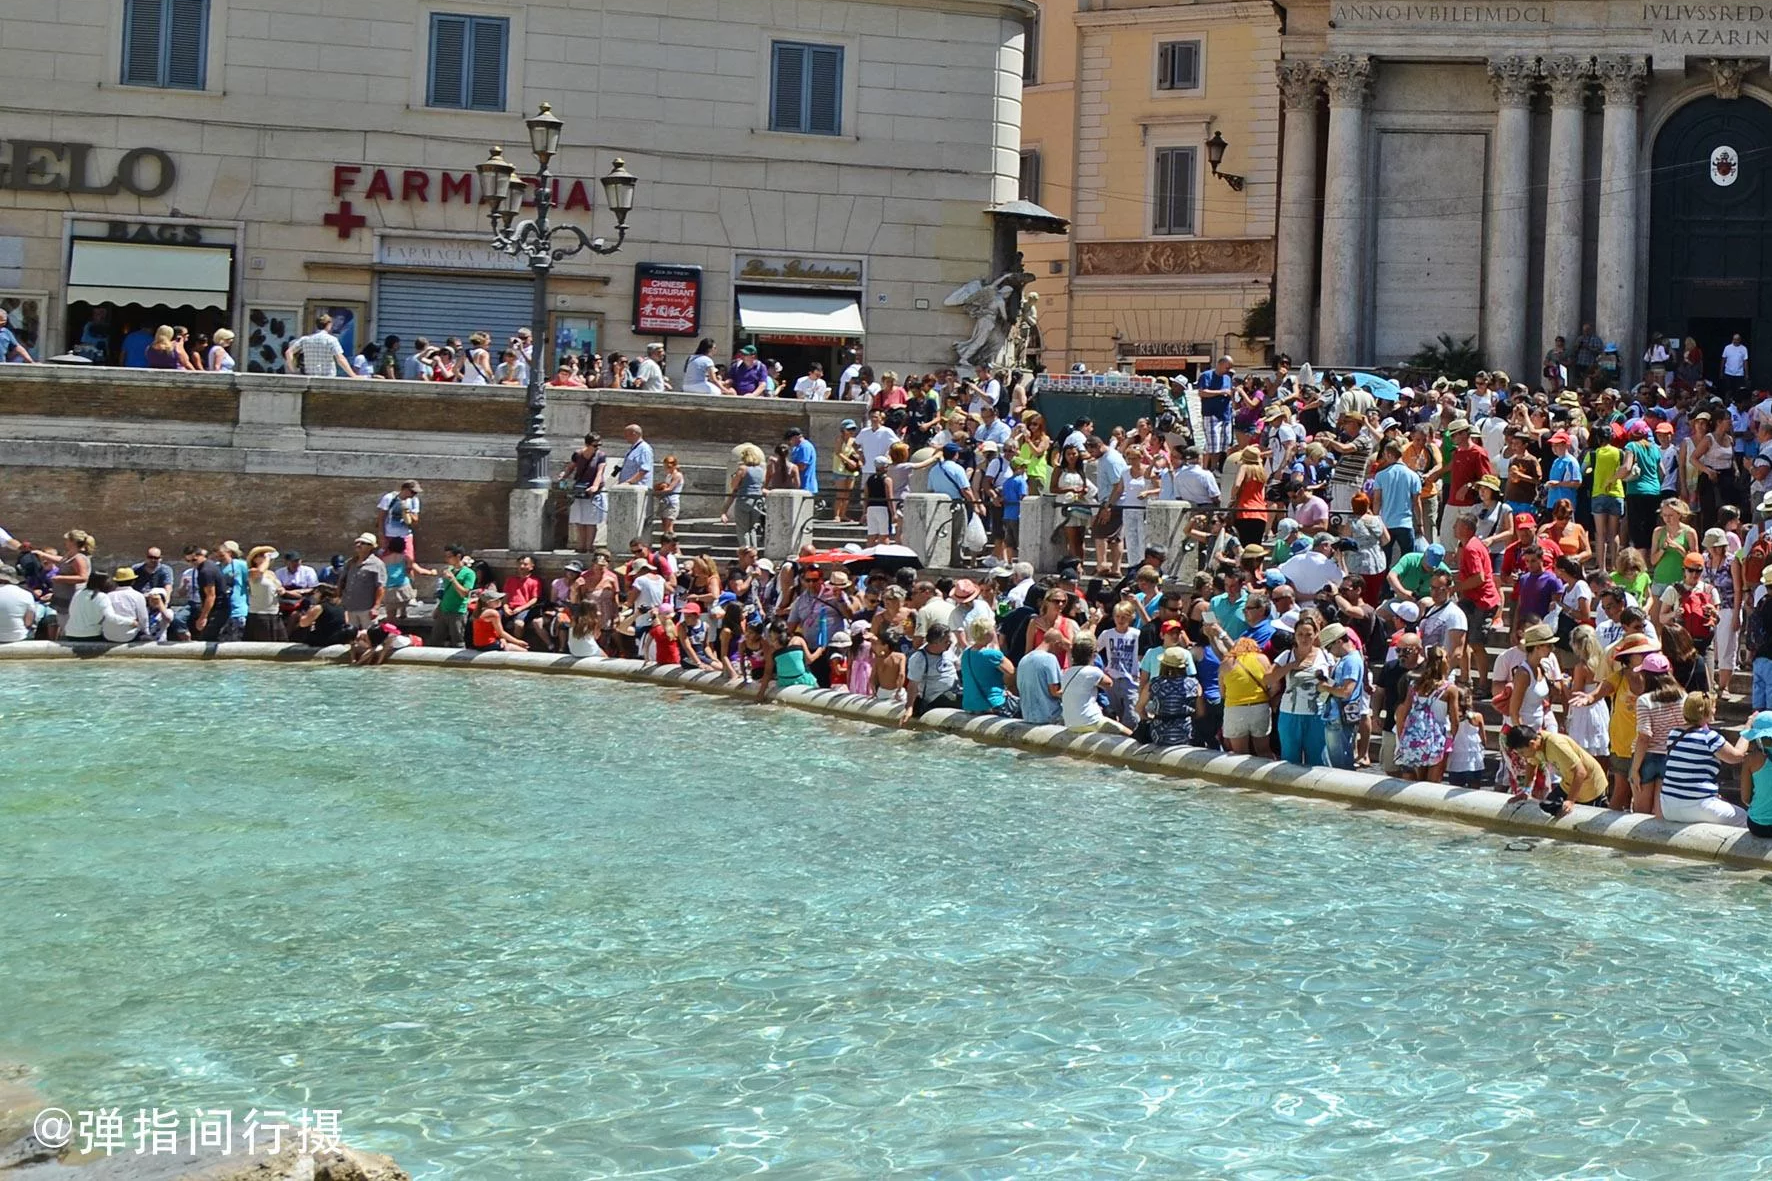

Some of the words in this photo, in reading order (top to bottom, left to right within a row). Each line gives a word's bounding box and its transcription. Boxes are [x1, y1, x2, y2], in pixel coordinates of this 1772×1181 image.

[334, 166, 591, 211] FARMCIA
[106, 220, 202, 243] BAGS
[651, 280, 687, 289] CHINESE
[641, 287, 696, 297] RESTAURANT
[1134, 342, 1163, 355] TREVI
